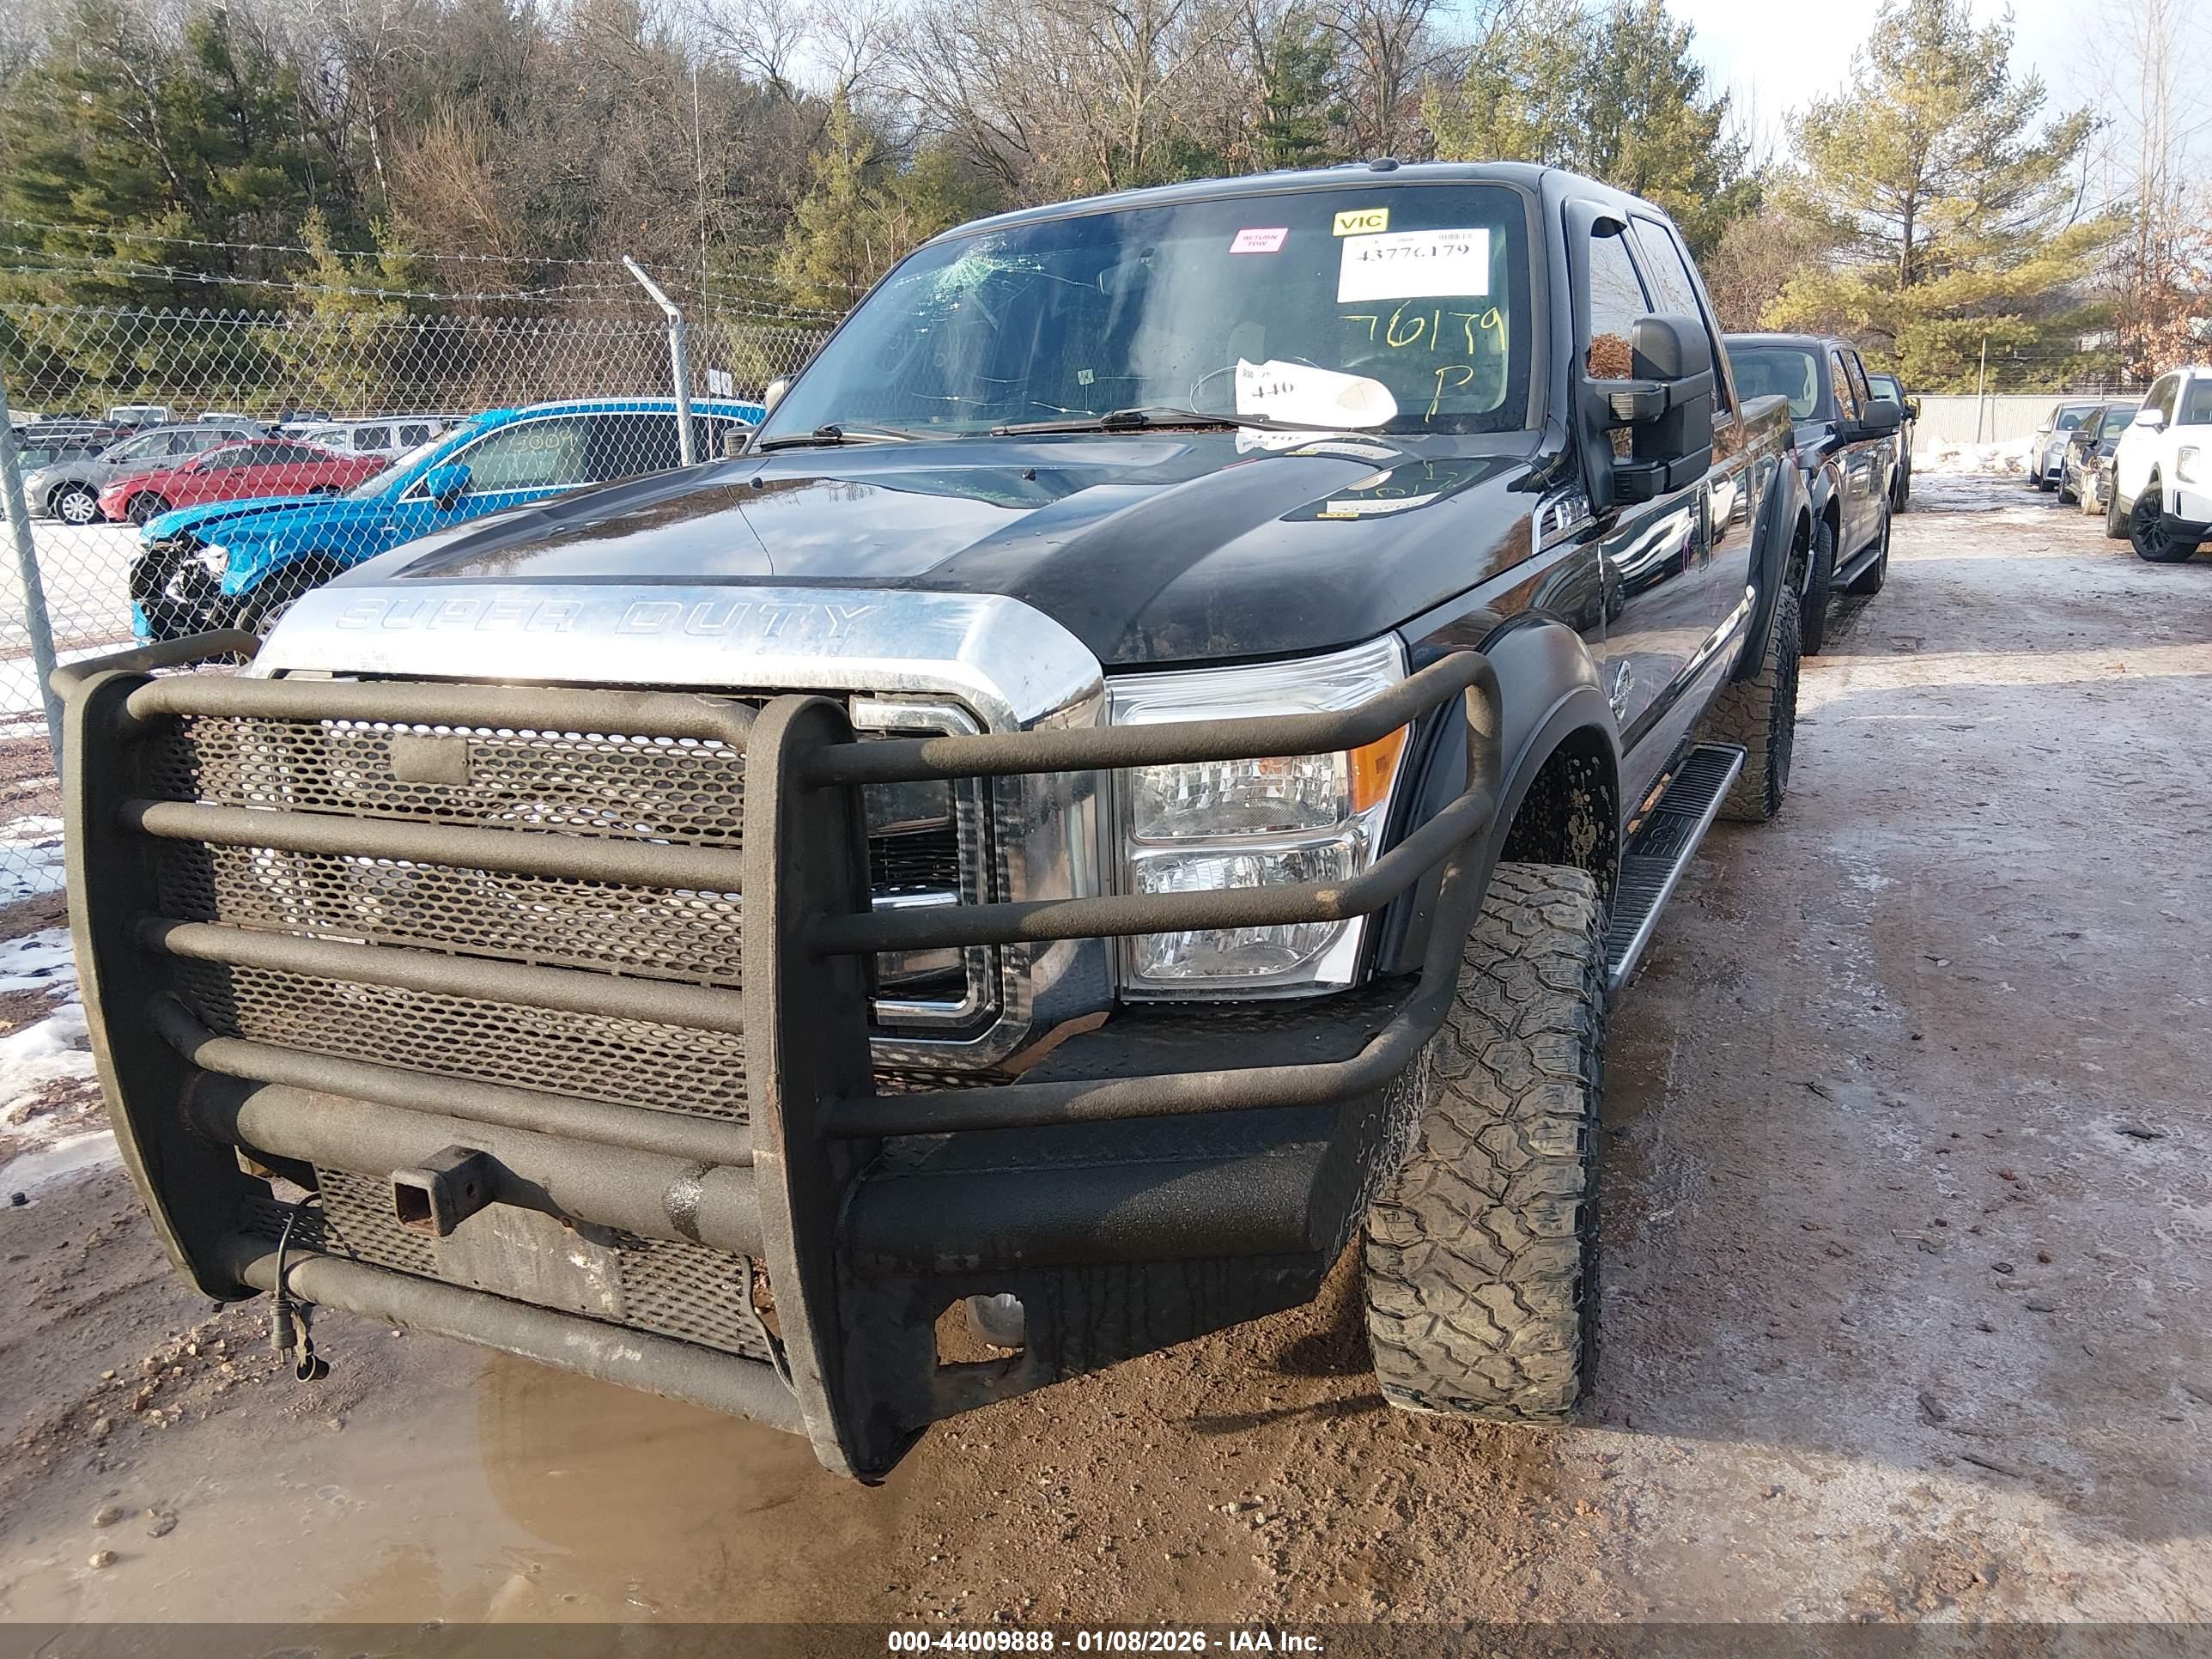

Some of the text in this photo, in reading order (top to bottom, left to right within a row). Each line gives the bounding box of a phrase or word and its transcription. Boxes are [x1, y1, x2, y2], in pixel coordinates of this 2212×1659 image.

[1340, 215, 1382, 228] VIC
[1356, 244, 1469, 262] 43776179
[337, 599, 878, 639] SUPER DUTY
